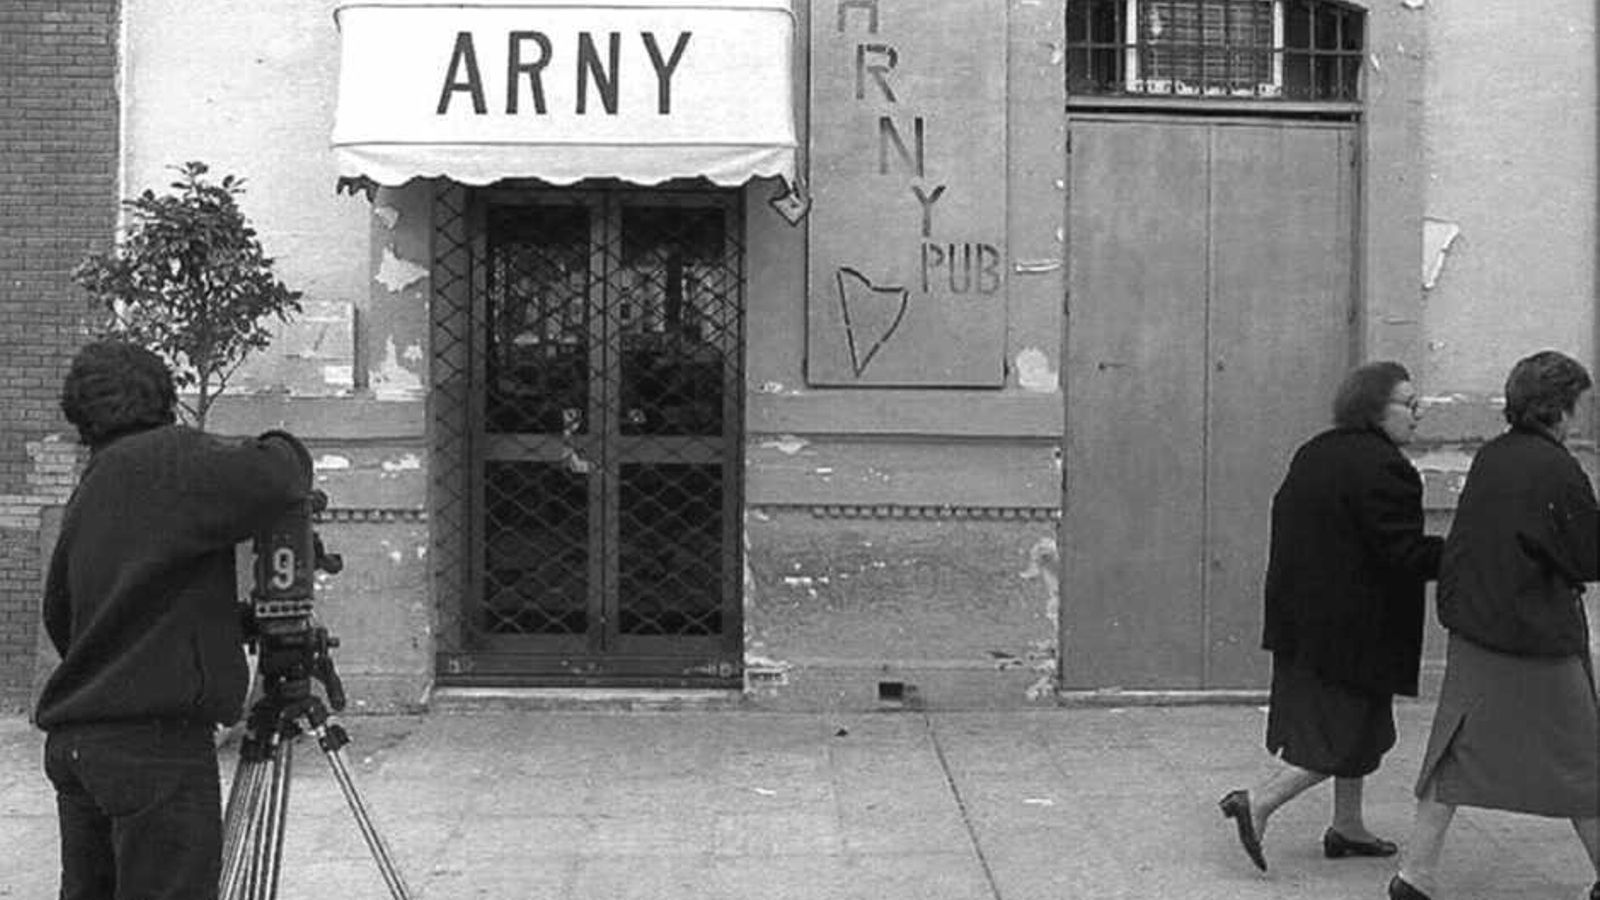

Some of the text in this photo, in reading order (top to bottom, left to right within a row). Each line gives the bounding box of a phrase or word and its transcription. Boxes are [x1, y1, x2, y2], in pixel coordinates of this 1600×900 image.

[436, 31, 693, 115] ARNY
[921, 242, 1000, 294] PUB
[272, 547, 295, 589] 9
